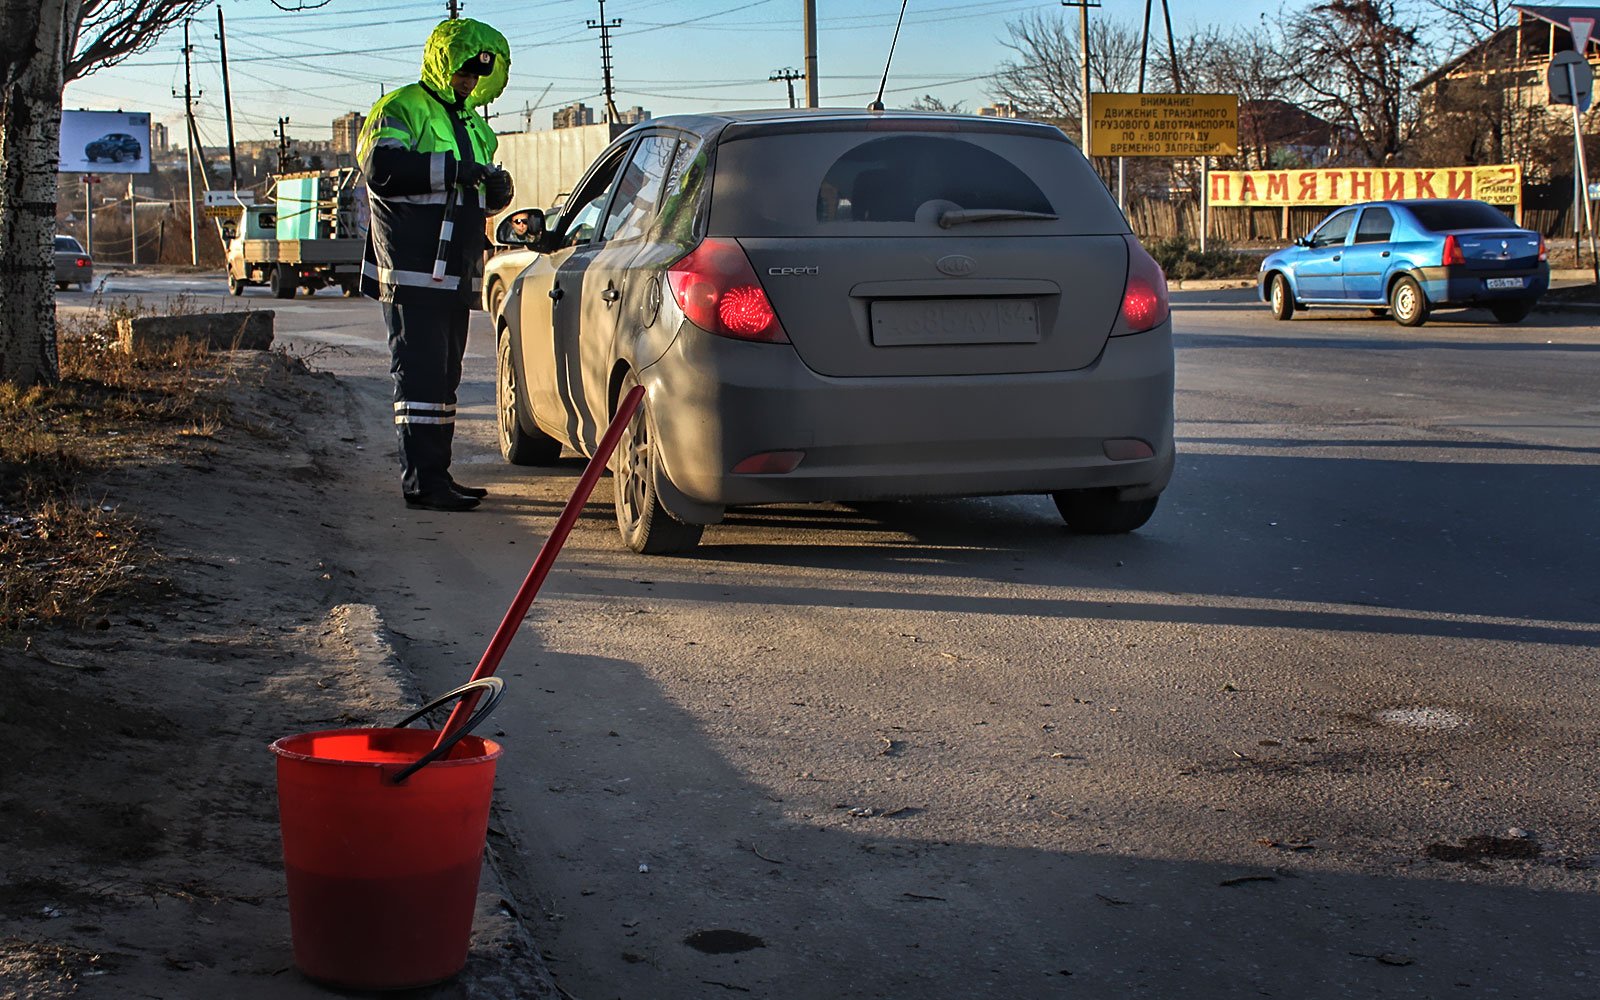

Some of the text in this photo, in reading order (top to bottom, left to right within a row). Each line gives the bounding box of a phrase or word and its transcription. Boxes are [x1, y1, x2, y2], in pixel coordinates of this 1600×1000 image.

[1140, 97, 1195, 107] ВНИМАНИЕ!
[1103, 108, 1228, 118] ДВИЖЕНИЕ ТРАНЗИТНОГО
[1094, 120, 1236, 129] ГРУЗОВОГО АВТОТРАНСПОРТА
[1122, 131, 1135, 141] ПО
[1110, 143, 1221, 153] ВРЕМЕННО ЗАПРЕЩЕНО
[1211, 171, 1473, 201] ПАМЯТНИКИ
